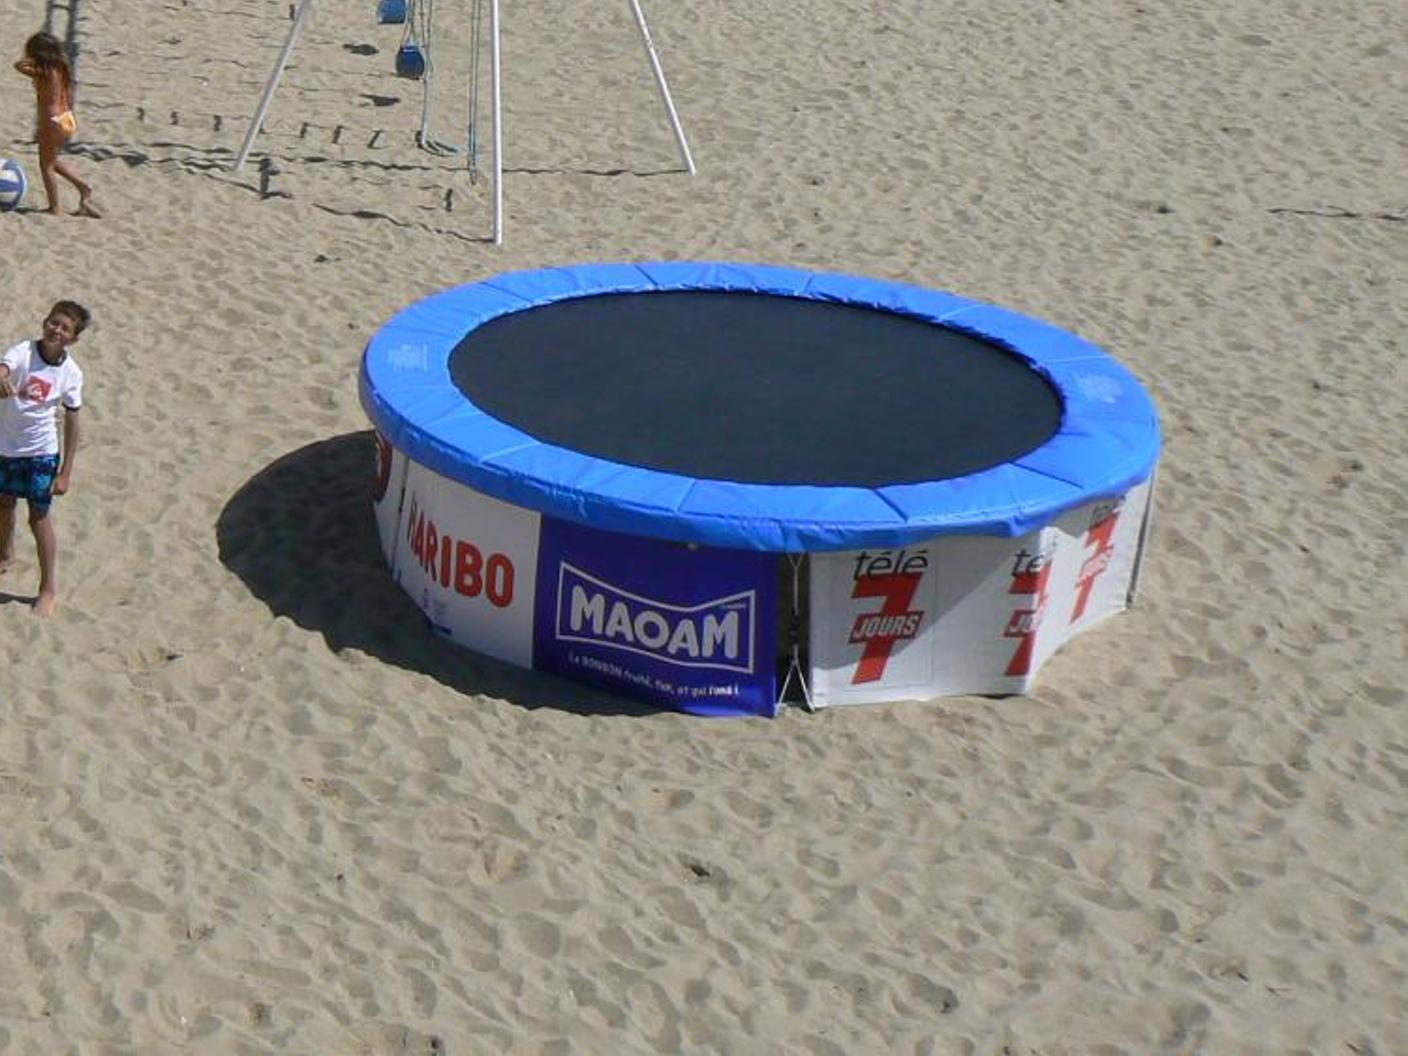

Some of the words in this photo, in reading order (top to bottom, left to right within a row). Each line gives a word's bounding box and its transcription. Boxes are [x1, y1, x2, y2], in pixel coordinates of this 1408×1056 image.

[408, 494, 515, 608] HARIBO
[853, 549, 930, 582] télé
[570, 585, 739, 659] MAOAM
[852, 614, 918, 638] JOURS
